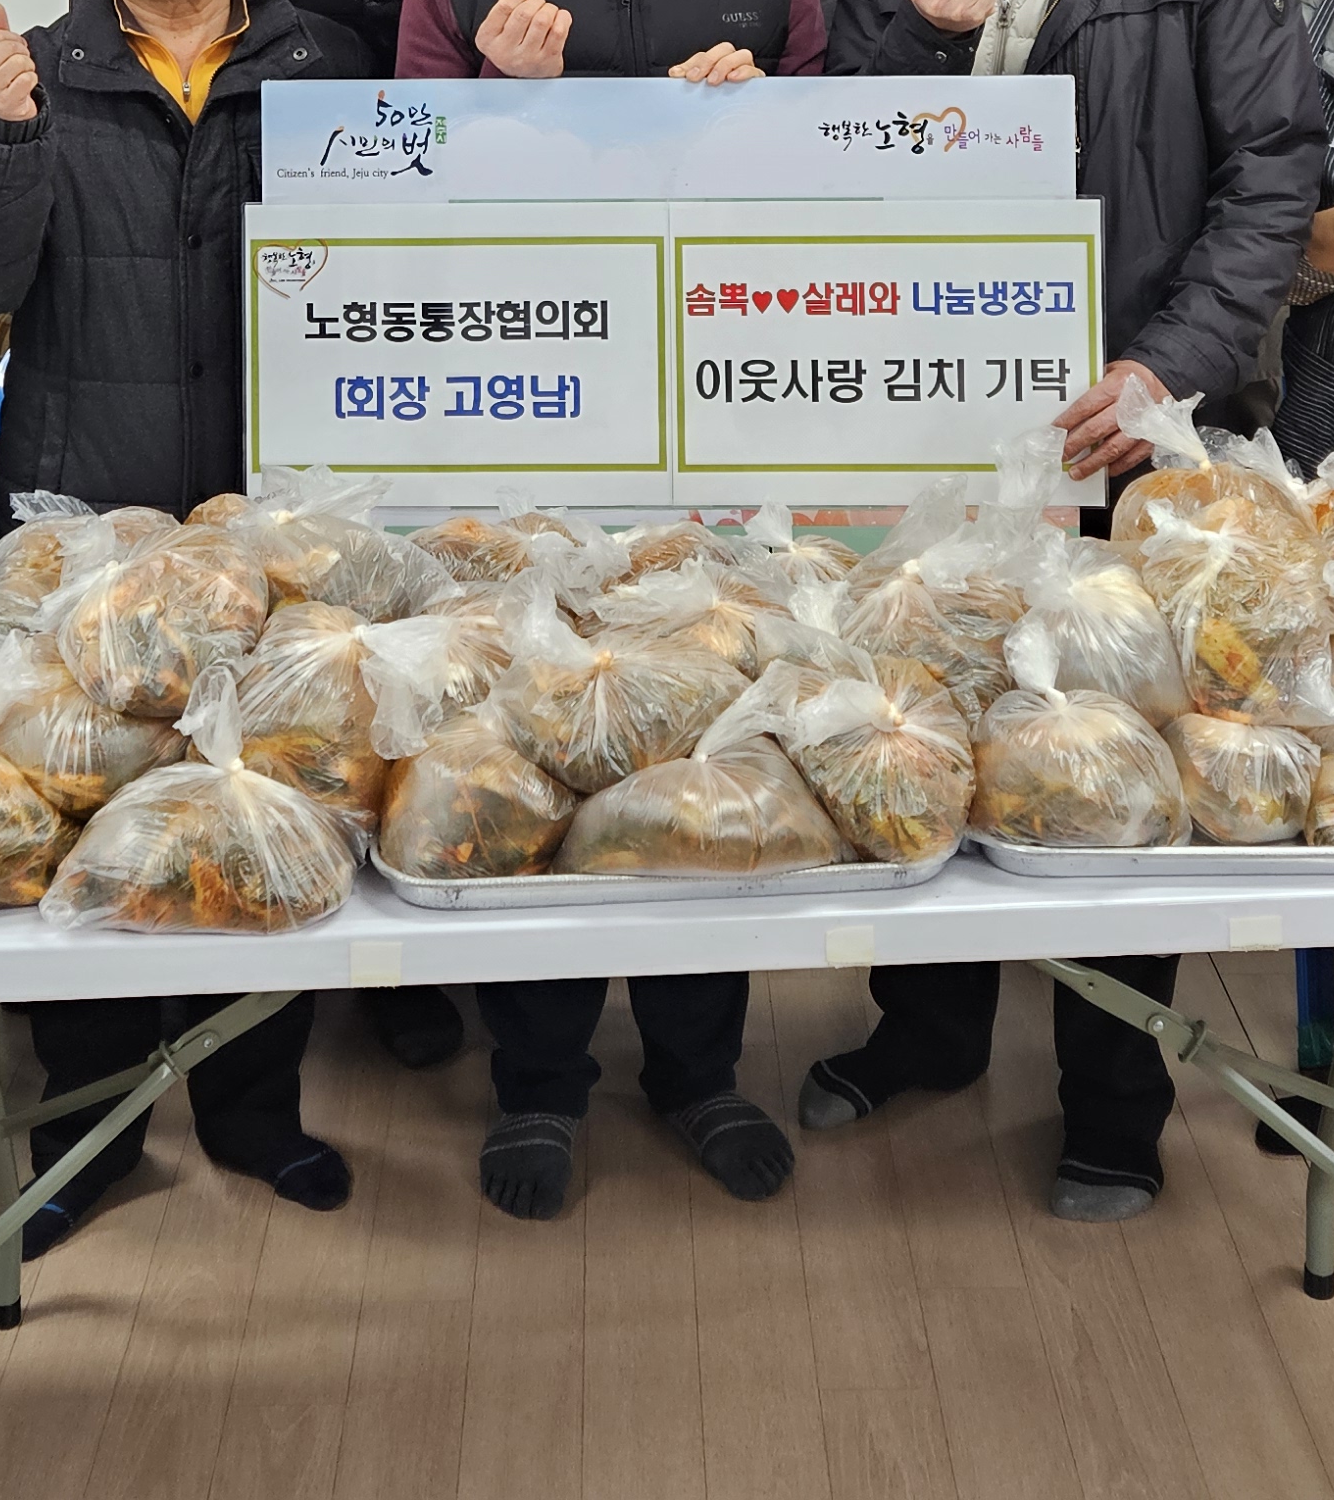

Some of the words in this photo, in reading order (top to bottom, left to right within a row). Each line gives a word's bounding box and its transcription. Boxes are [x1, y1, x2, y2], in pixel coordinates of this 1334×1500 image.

[375, 94, 433, 127] 50만
[320, 127, 395, 167] 시민의
[391, 127, 434, 176] 벗
[818, 120, 873, 151] 행복한
[944, 124, 981, 150] 만들어
[1005, 125, 1044, 151] 사람들
[276, 168, 315, 178] Citizen's
[320, 168, 350, 180] friend,
[351, 168, 370, 180] Jeju
[372, 168, 389, 180] city
[912, 281, 1076, 316] 나눔냉장고
[304, 299, 609, 343] 노형동통장협의회
[695, 358, 867, 404] 이웃사랑
[882, 358, 966, 402] 김치
[984, 357, 1071, 403] 기탁
